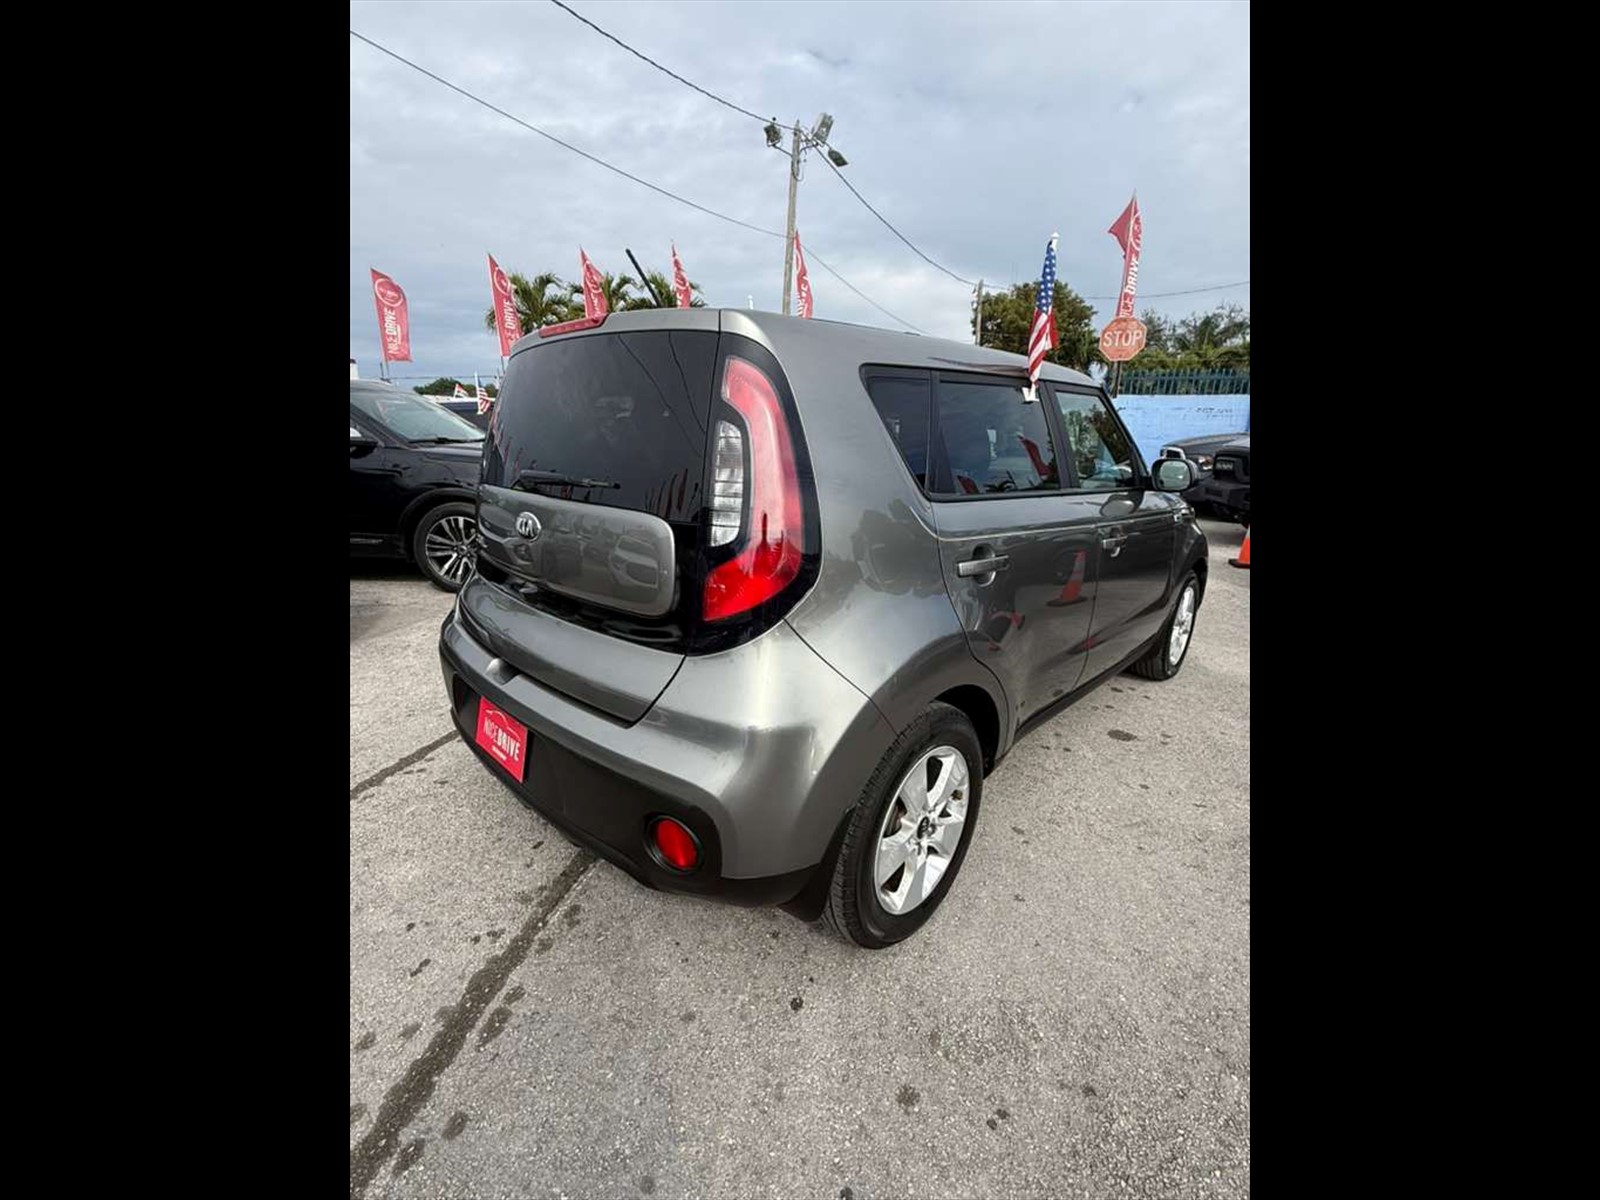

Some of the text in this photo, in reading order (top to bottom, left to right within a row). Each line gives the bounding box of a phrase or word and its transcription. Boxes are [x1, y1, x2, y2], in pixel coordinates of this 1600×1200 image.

[1124, 256, 1139, 294] DRIVE
[383, 307, 397, 335] DRIVE
[1103, 331, 1143, 347] STOP
[516, 517, 535, 537] KIA
